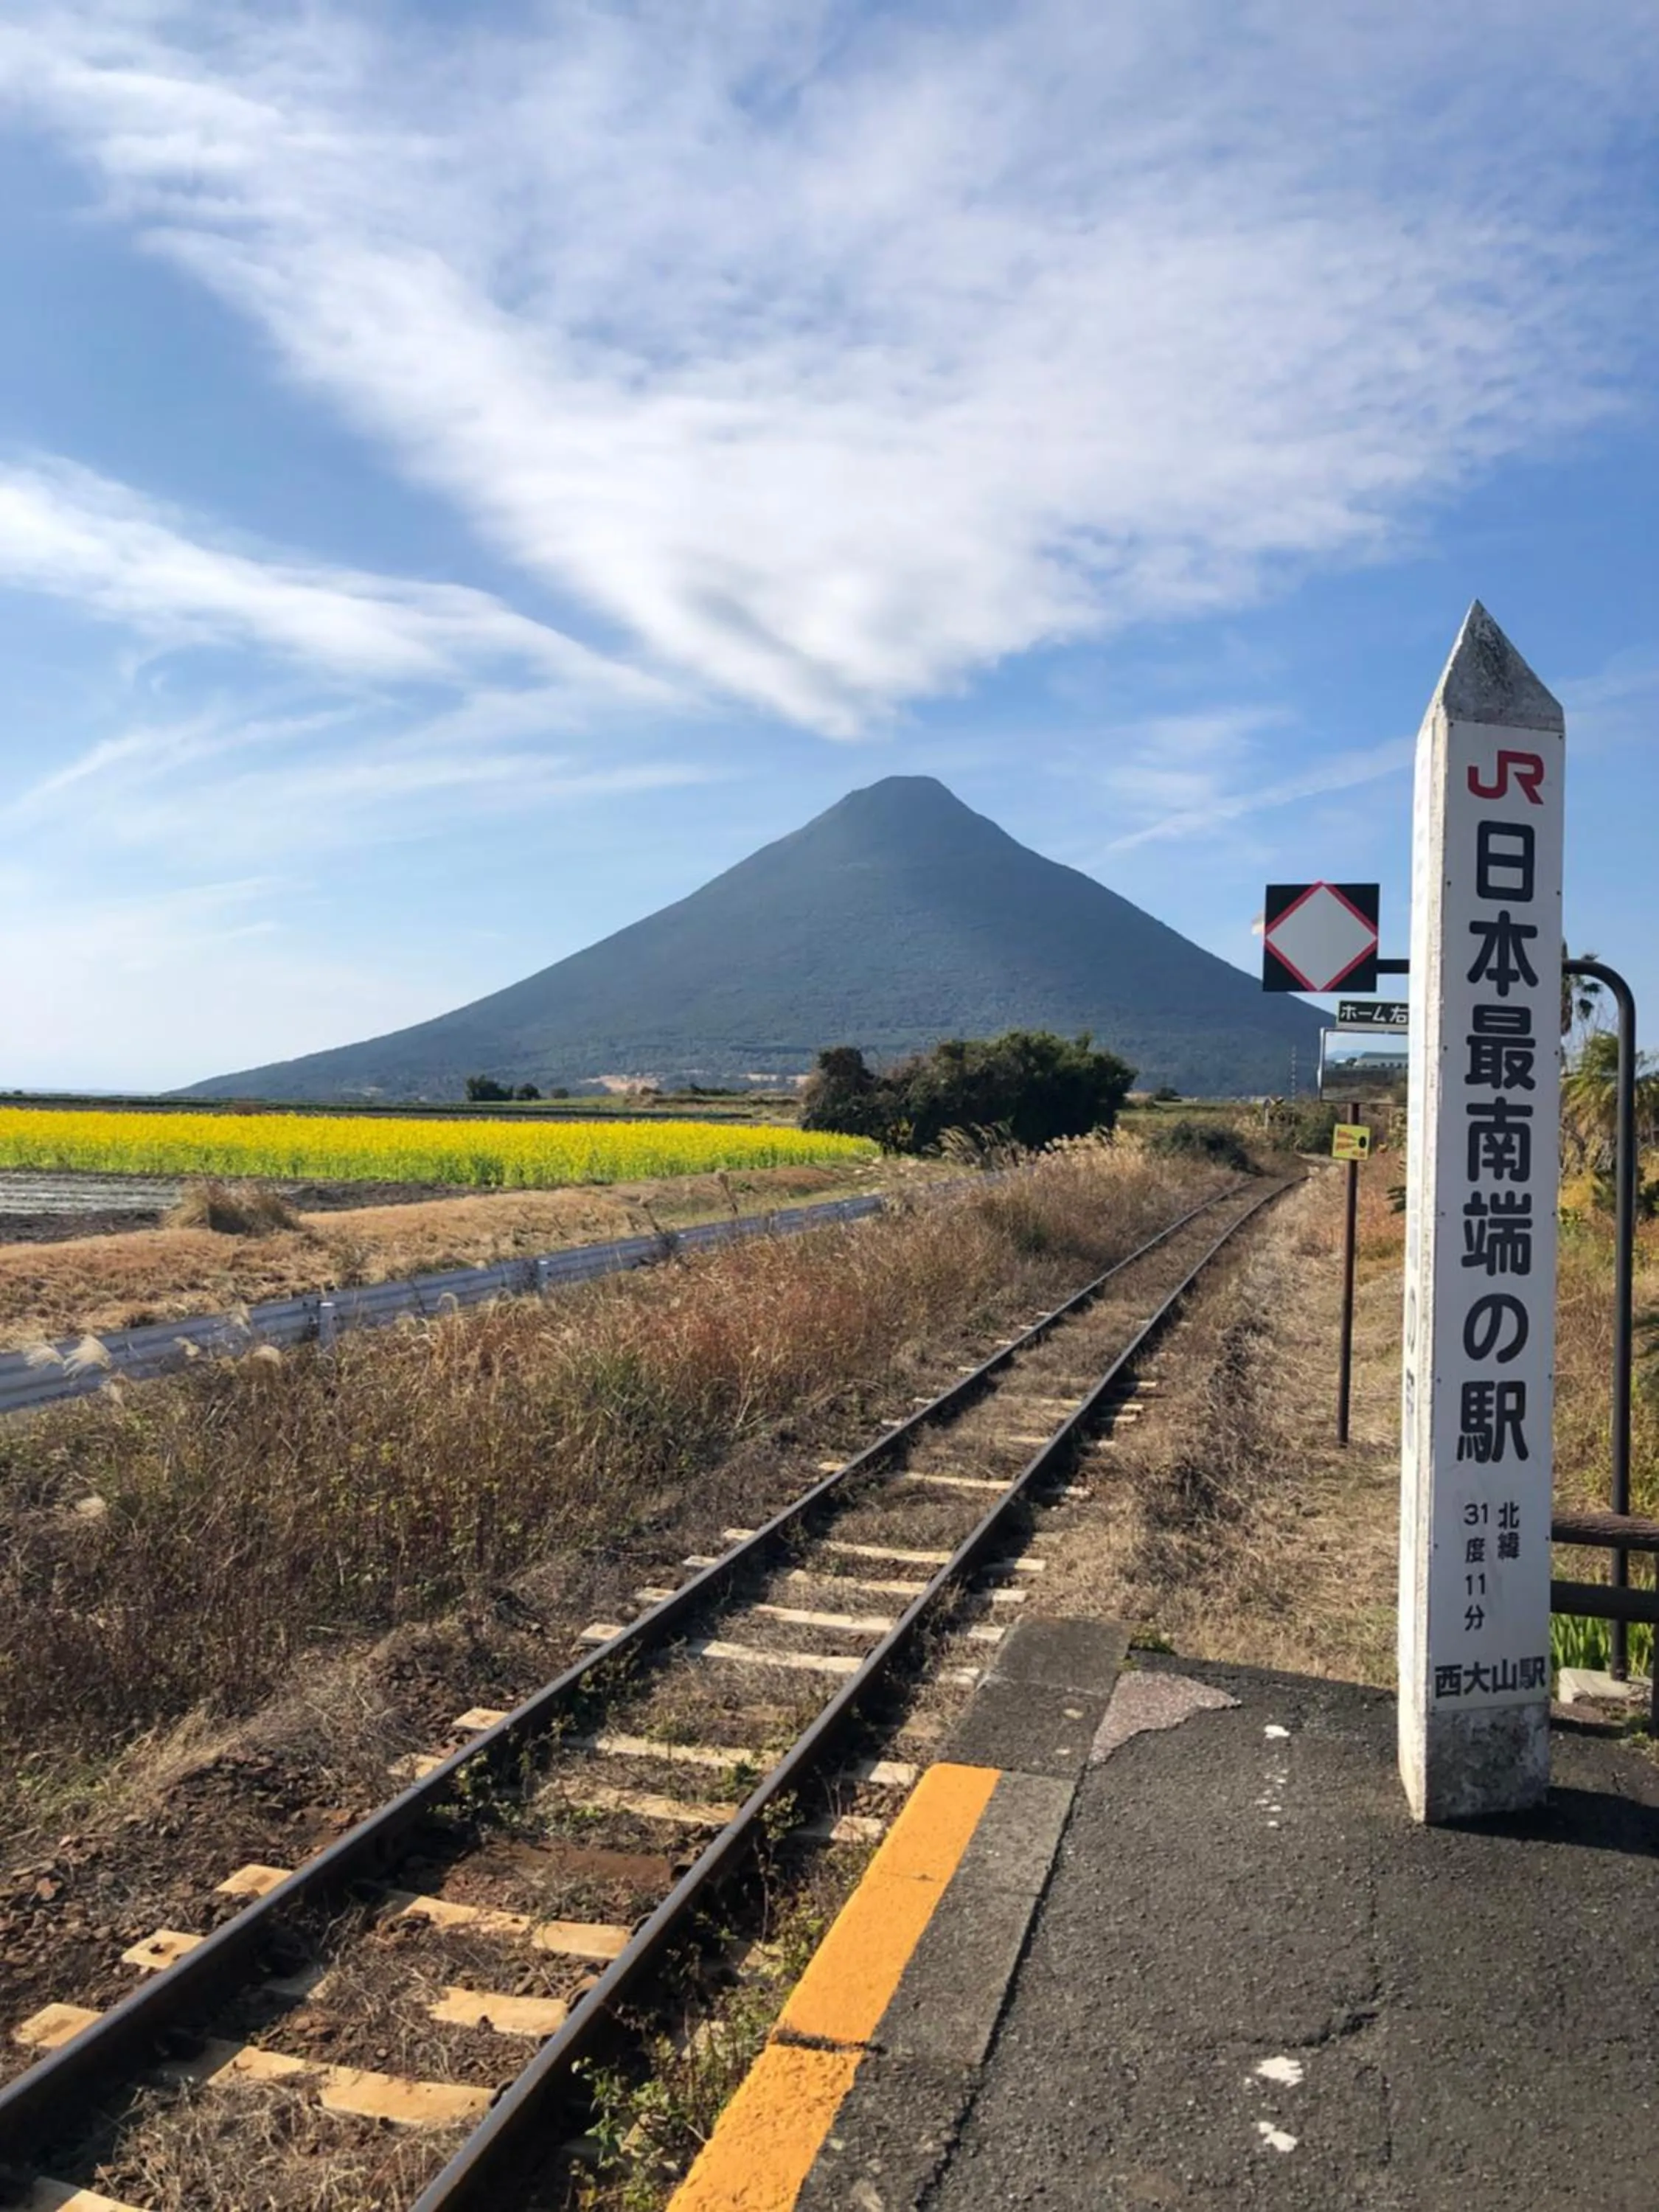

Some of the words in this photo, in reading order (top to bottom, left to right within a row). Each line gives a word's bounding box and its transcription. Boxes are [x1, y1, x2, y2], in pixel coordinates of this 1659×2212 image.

[1467, 750, 1544, 805] JR
[1457, 820, 1539, 1463] 日本最南端の駅
[1498, 1502, 1520, 1559] 北緯
[1435, 1657, 1545, 1698] 西大山駅
